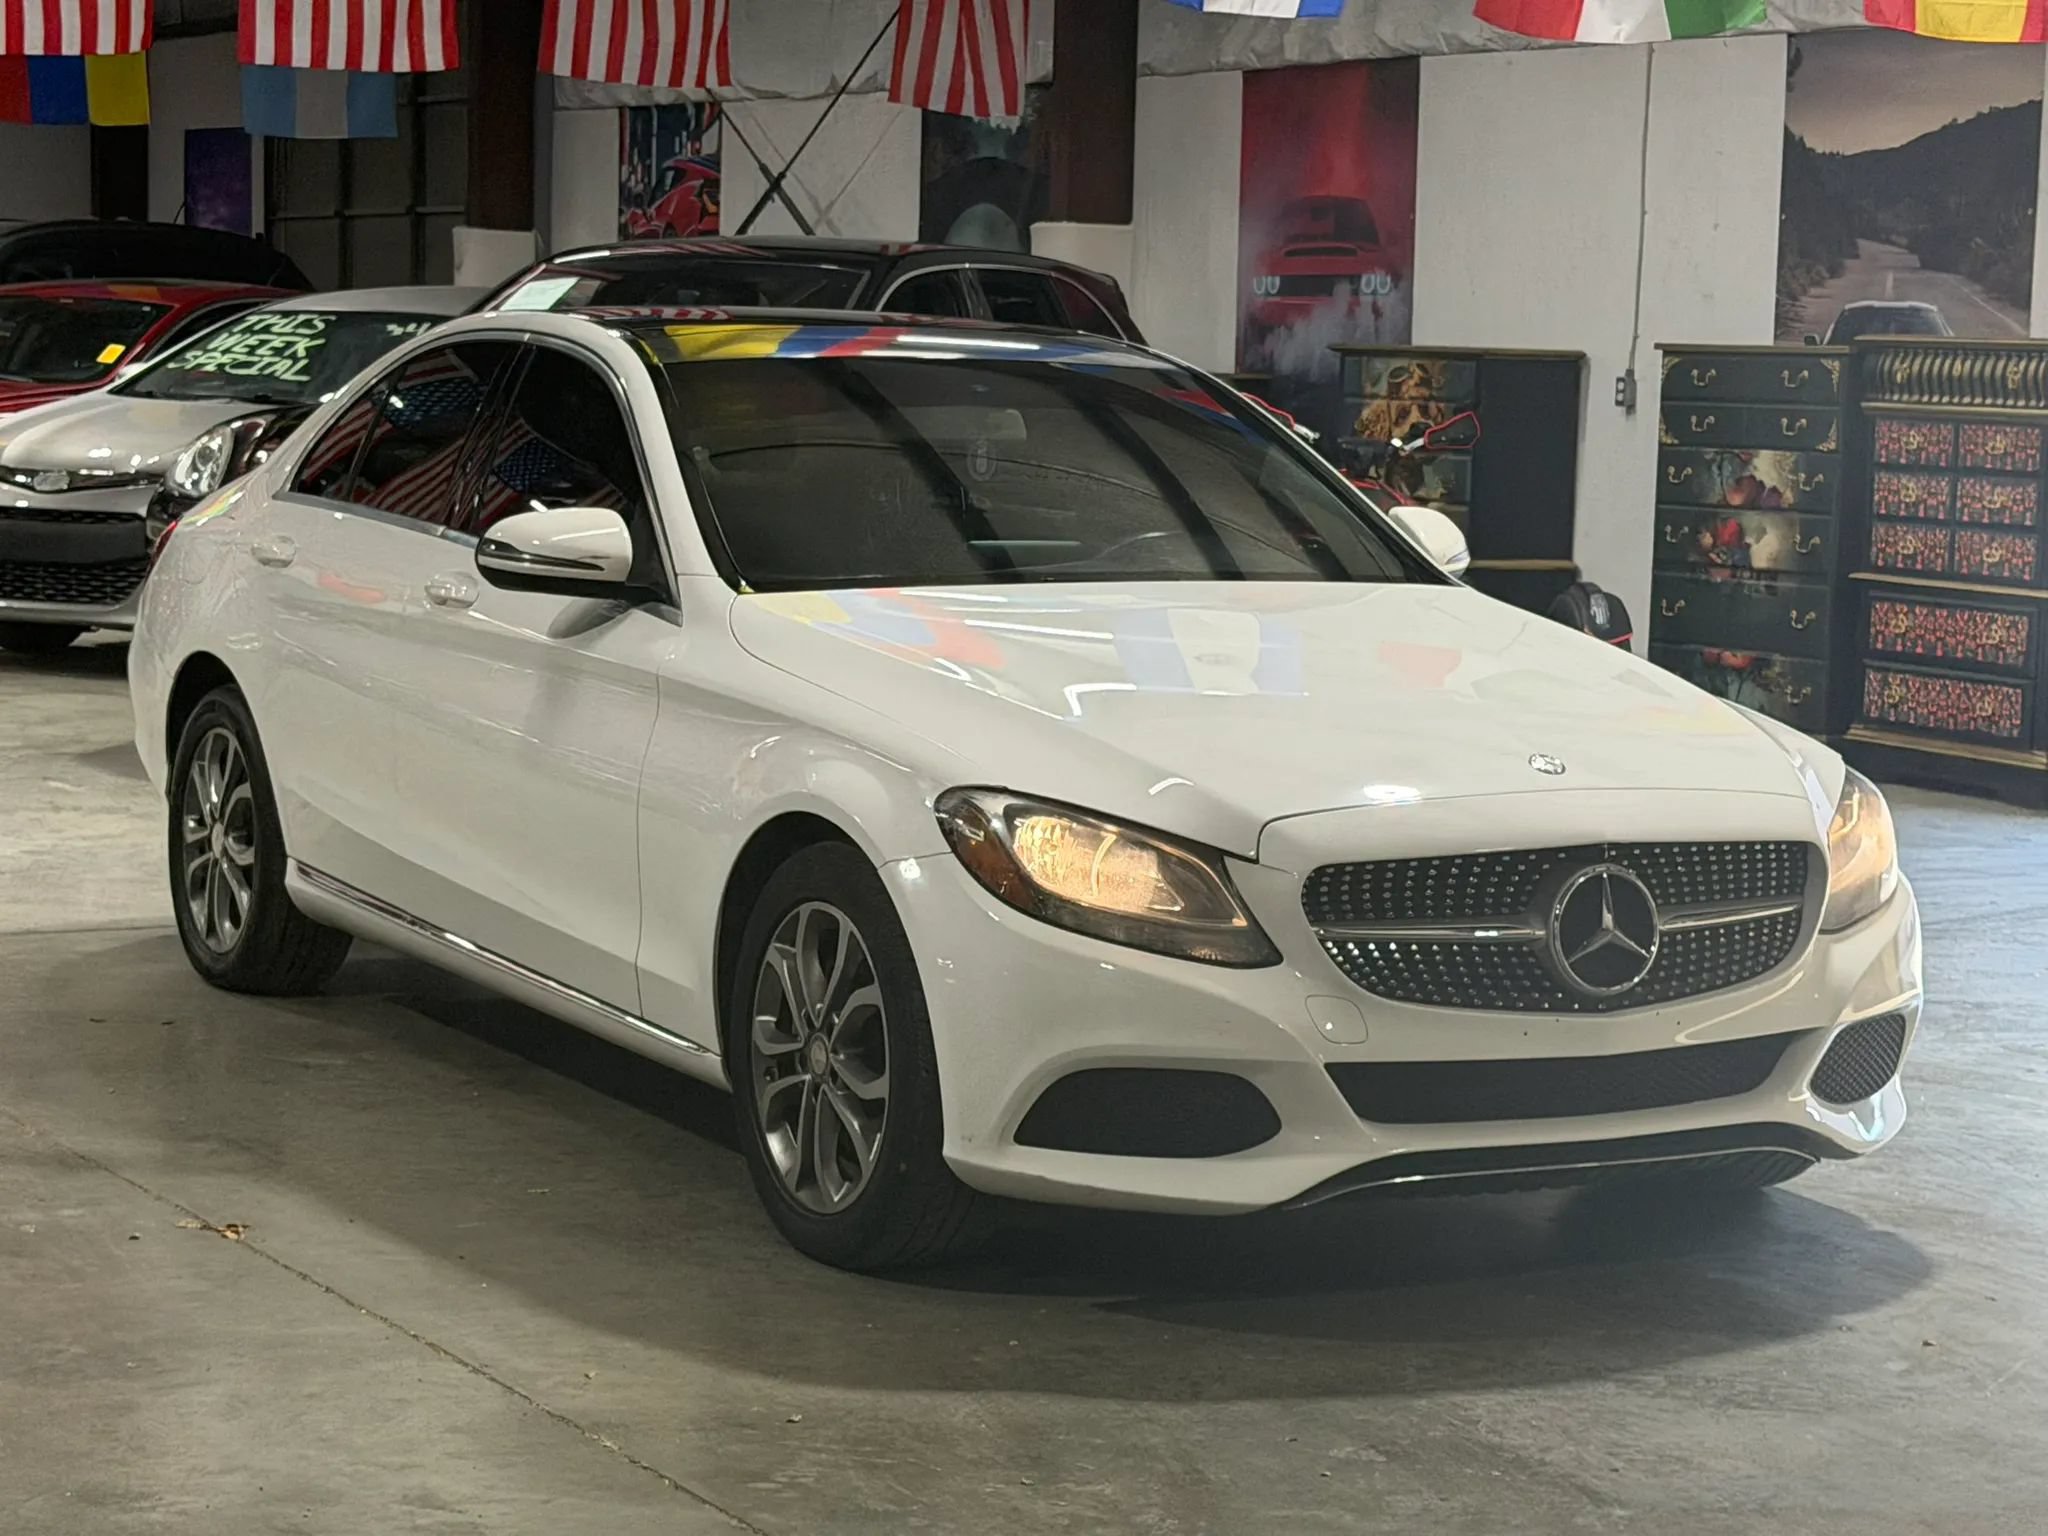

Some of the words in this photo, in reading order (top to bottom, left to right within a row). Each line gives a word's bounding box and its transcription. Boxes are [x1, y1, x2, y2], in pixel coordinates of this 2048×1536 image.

[233, 314, 336, 335] THIS
[207, 333, 325, 357] WEEK
[168, 351, 311, 381] SPECIAL
